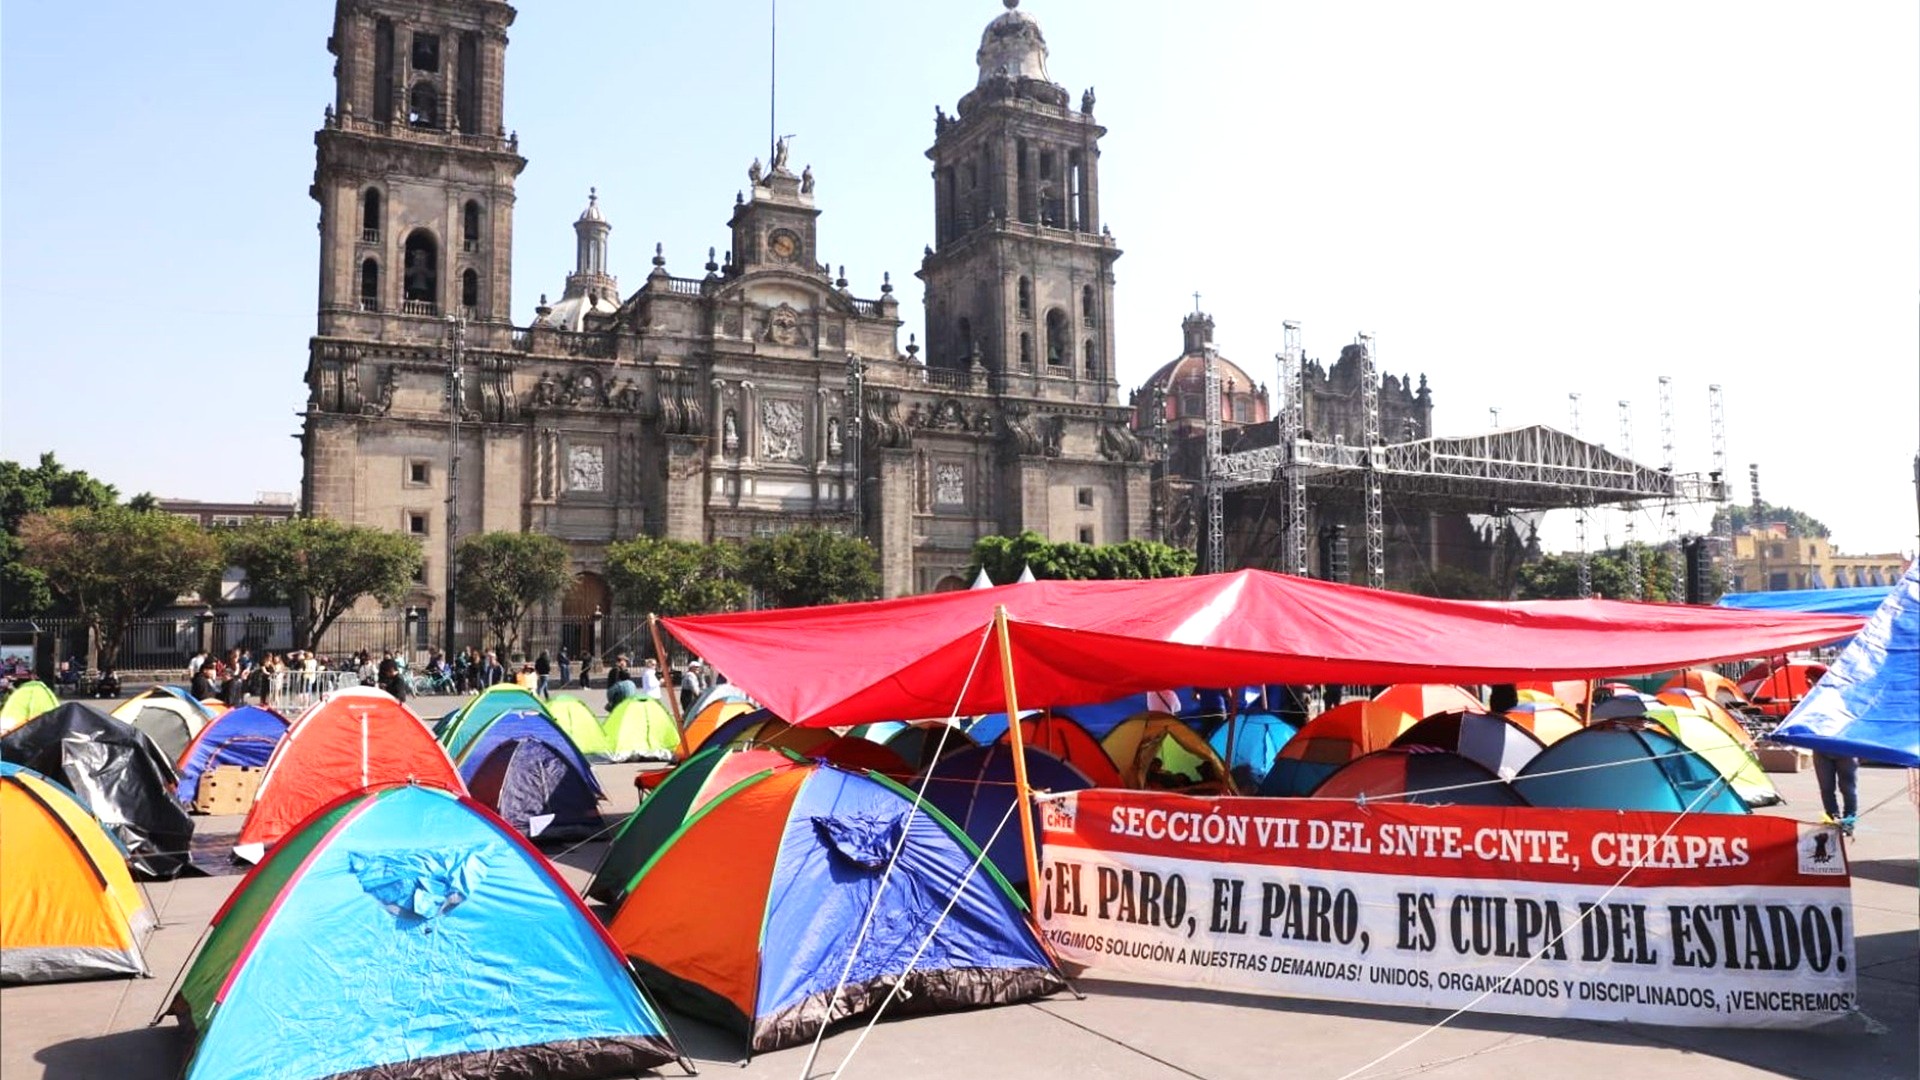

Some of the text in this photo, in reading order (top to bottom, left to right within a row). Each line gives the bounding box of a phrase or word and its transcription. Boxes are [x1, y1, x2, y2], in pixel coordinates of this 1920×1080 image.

[1047, 814, 1072, 828] CNTE
[1110, 806, 1749, 872] SECCIÓN VII DEL SNTE-CNTE, CHIAPAS
[1043, 861, 1847, 973] ¡EL PARO, EL PARO, ES CULPA DEL ESTADO!
[1105, 938, 1176, 963] SOLUCIÓN
[1176, 949, 1186, 965] A
[1190, 949, 1267, 972] NUESTRAS
[1271, 957, 1362, 982] DEMANDAS!
[1369, 966, 1433, 991] UNIDOS,
[1438, 971, 1559, 998] ORGANIZADOS
[1563, 981, 1574, 999] Y
[1579, 981, 1720, 1012] DISCIPLINADOS,
